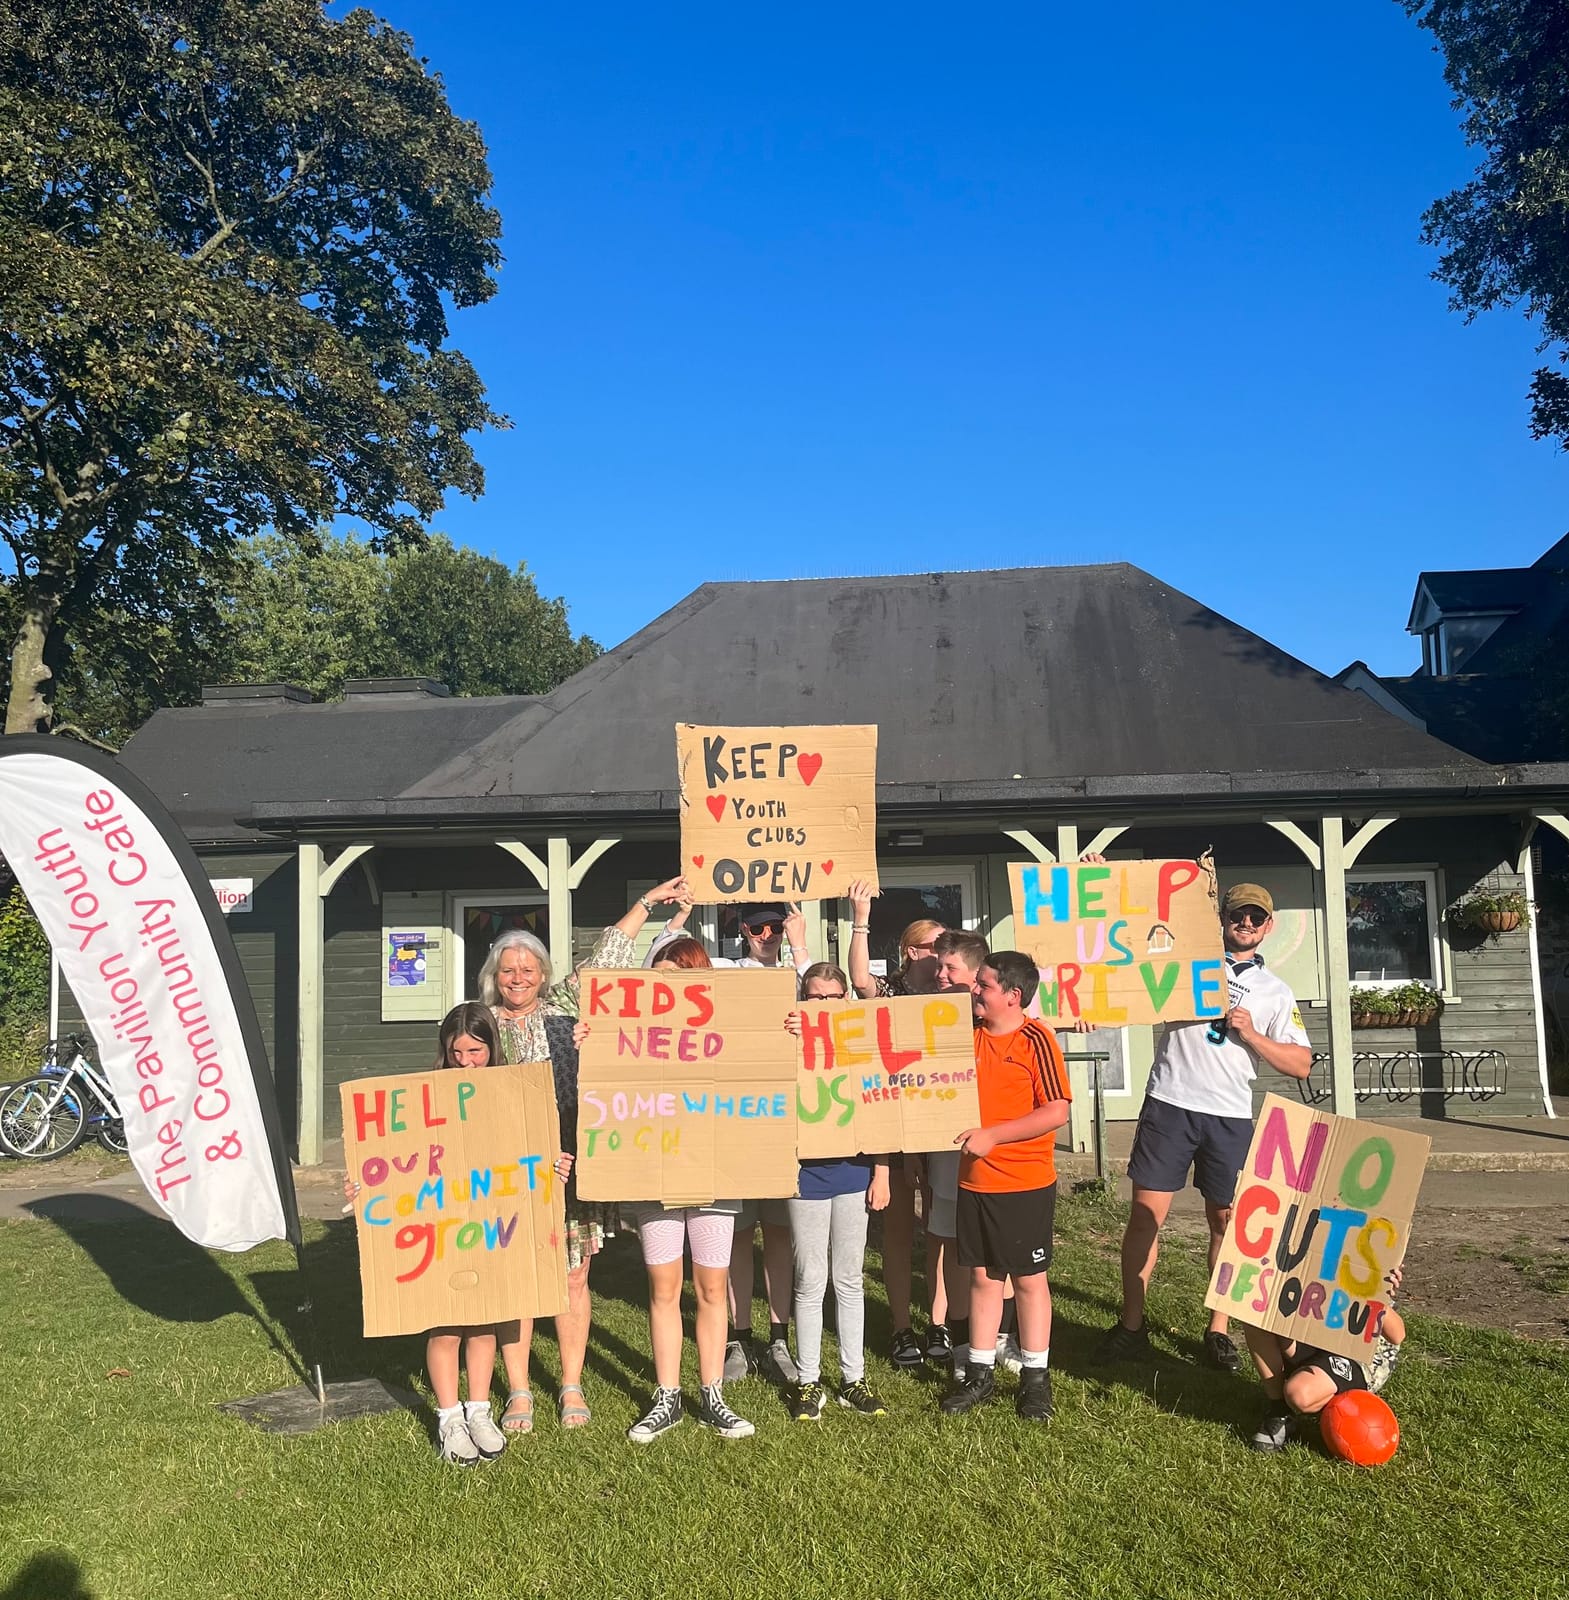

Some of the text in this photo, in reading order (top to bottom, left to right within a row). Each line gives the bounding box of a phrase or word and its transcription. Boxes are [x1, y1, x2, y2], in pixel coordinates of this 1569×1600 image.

[703, 735, 797, 788] KEEP
[732, 798, 786, 819] YOUTH
[747, 827, 806, 847] CLUBS
[215, 890, 247, 904] lion
[713, 858, 811, 893] OPEN
[1021, 861, 1200, 925] HELP
[1075, 920, 1134, 966] US
[84, 789, 242, 1162] & Community Cafe
[1227, 979, 1251, 993] MBRO
[34, 827, 191, 1201] The Pavilion Youth
[589, 977, 715, 1027] KIDS
[618, 1027, 724, 1062] NEED
[800, 1000, 960, 1075] HELP
[797, 1074, 855, 1127] US
[862, 1073, 881, 1090] WE
[888, 1073, 926, 1088] NEED
[353, 1082, 475, 1142] HELP
[362, 1144, 445, 1186] OUR
[583, 1129, 622, 1158] TO
[1254, 1106, 1396, 1209] NO
[363, 1155, 556, 1225] COMUNITY
[1235, 1185, 1397, 1298] CUTS
